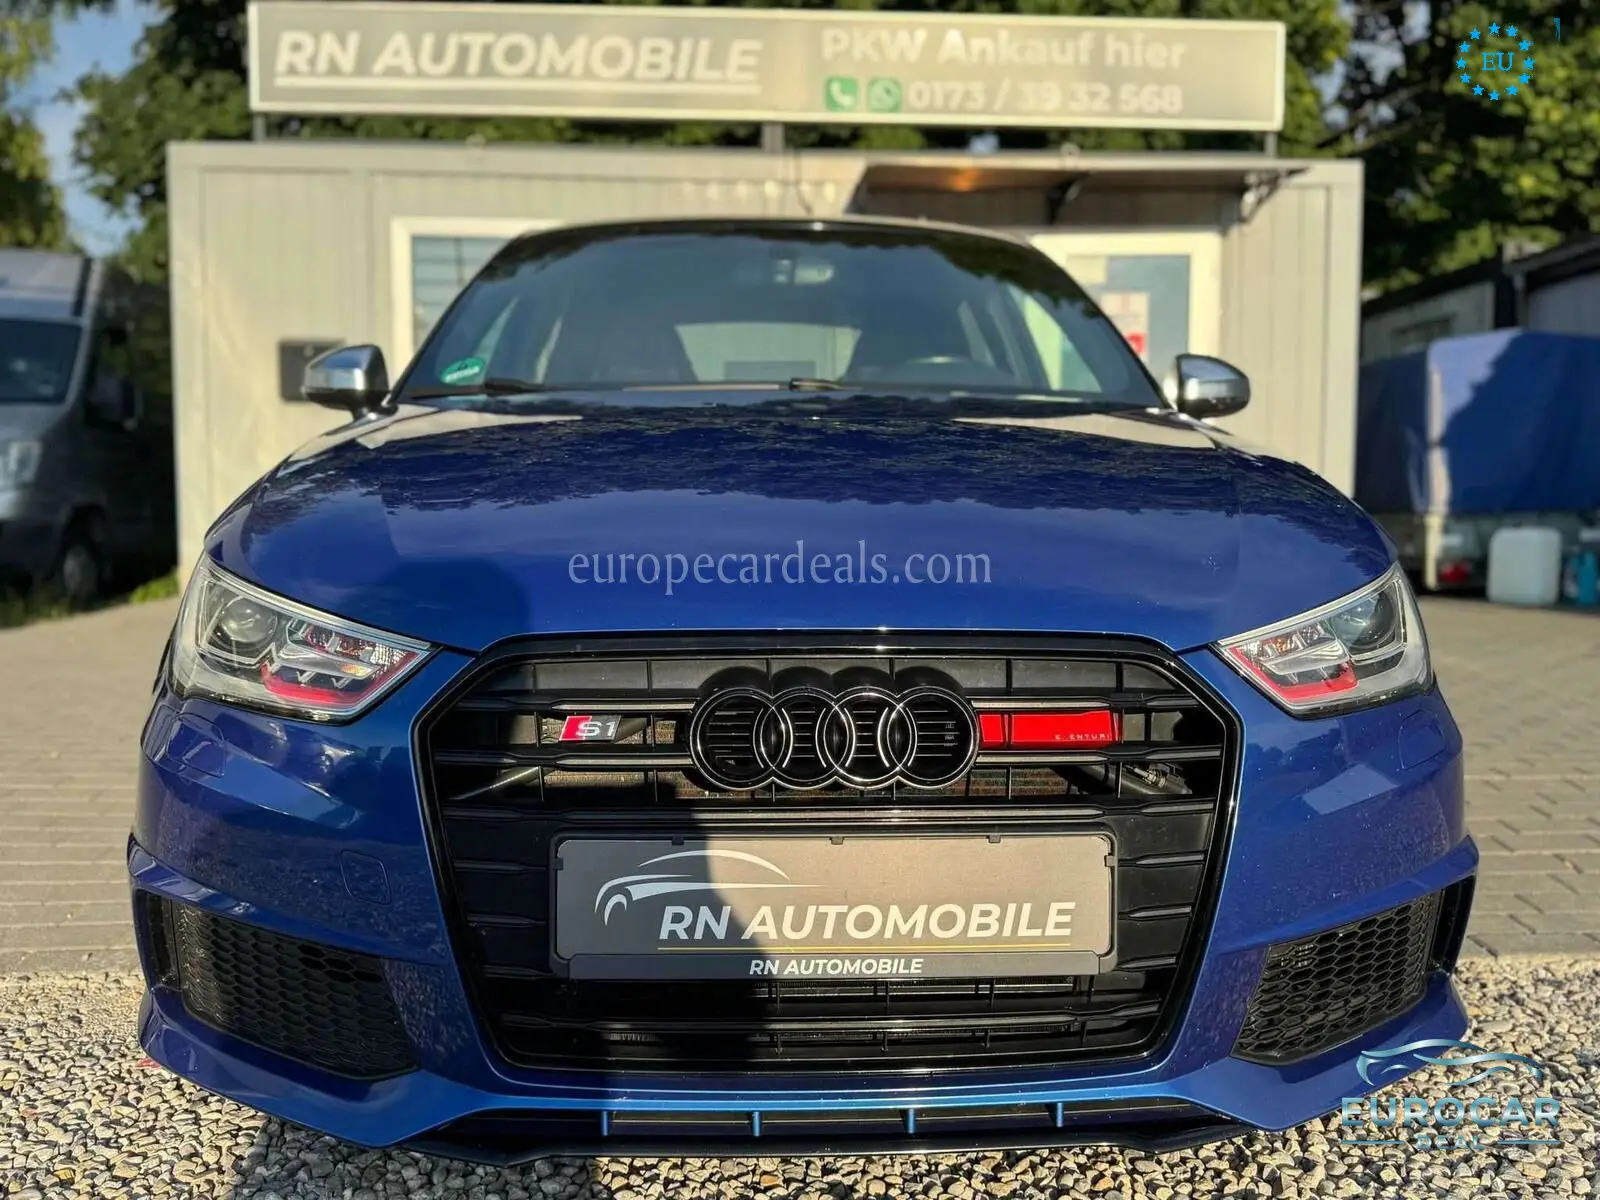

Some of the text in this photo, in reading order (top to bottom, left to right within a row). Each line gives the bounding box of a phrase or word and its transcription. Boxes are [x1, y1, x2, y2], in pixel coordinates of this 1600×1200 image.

[275, 30, 762, 82] RN AUTOMOBILE
[821, 27, 1187, 68] PKW Ankauf hier
[909, 80, 985, 110] 0173
[1018, 81, 1062, 112] 39
[1069, 82, 1111, 112] 32
[1118, 83, 1183, 114] 568
[575, 721, 616, 737] S1
[659, 902, 1076, 940] RN AUTOMOBILE
[749, 958, 924, 975] RN AUTOMOBILE
